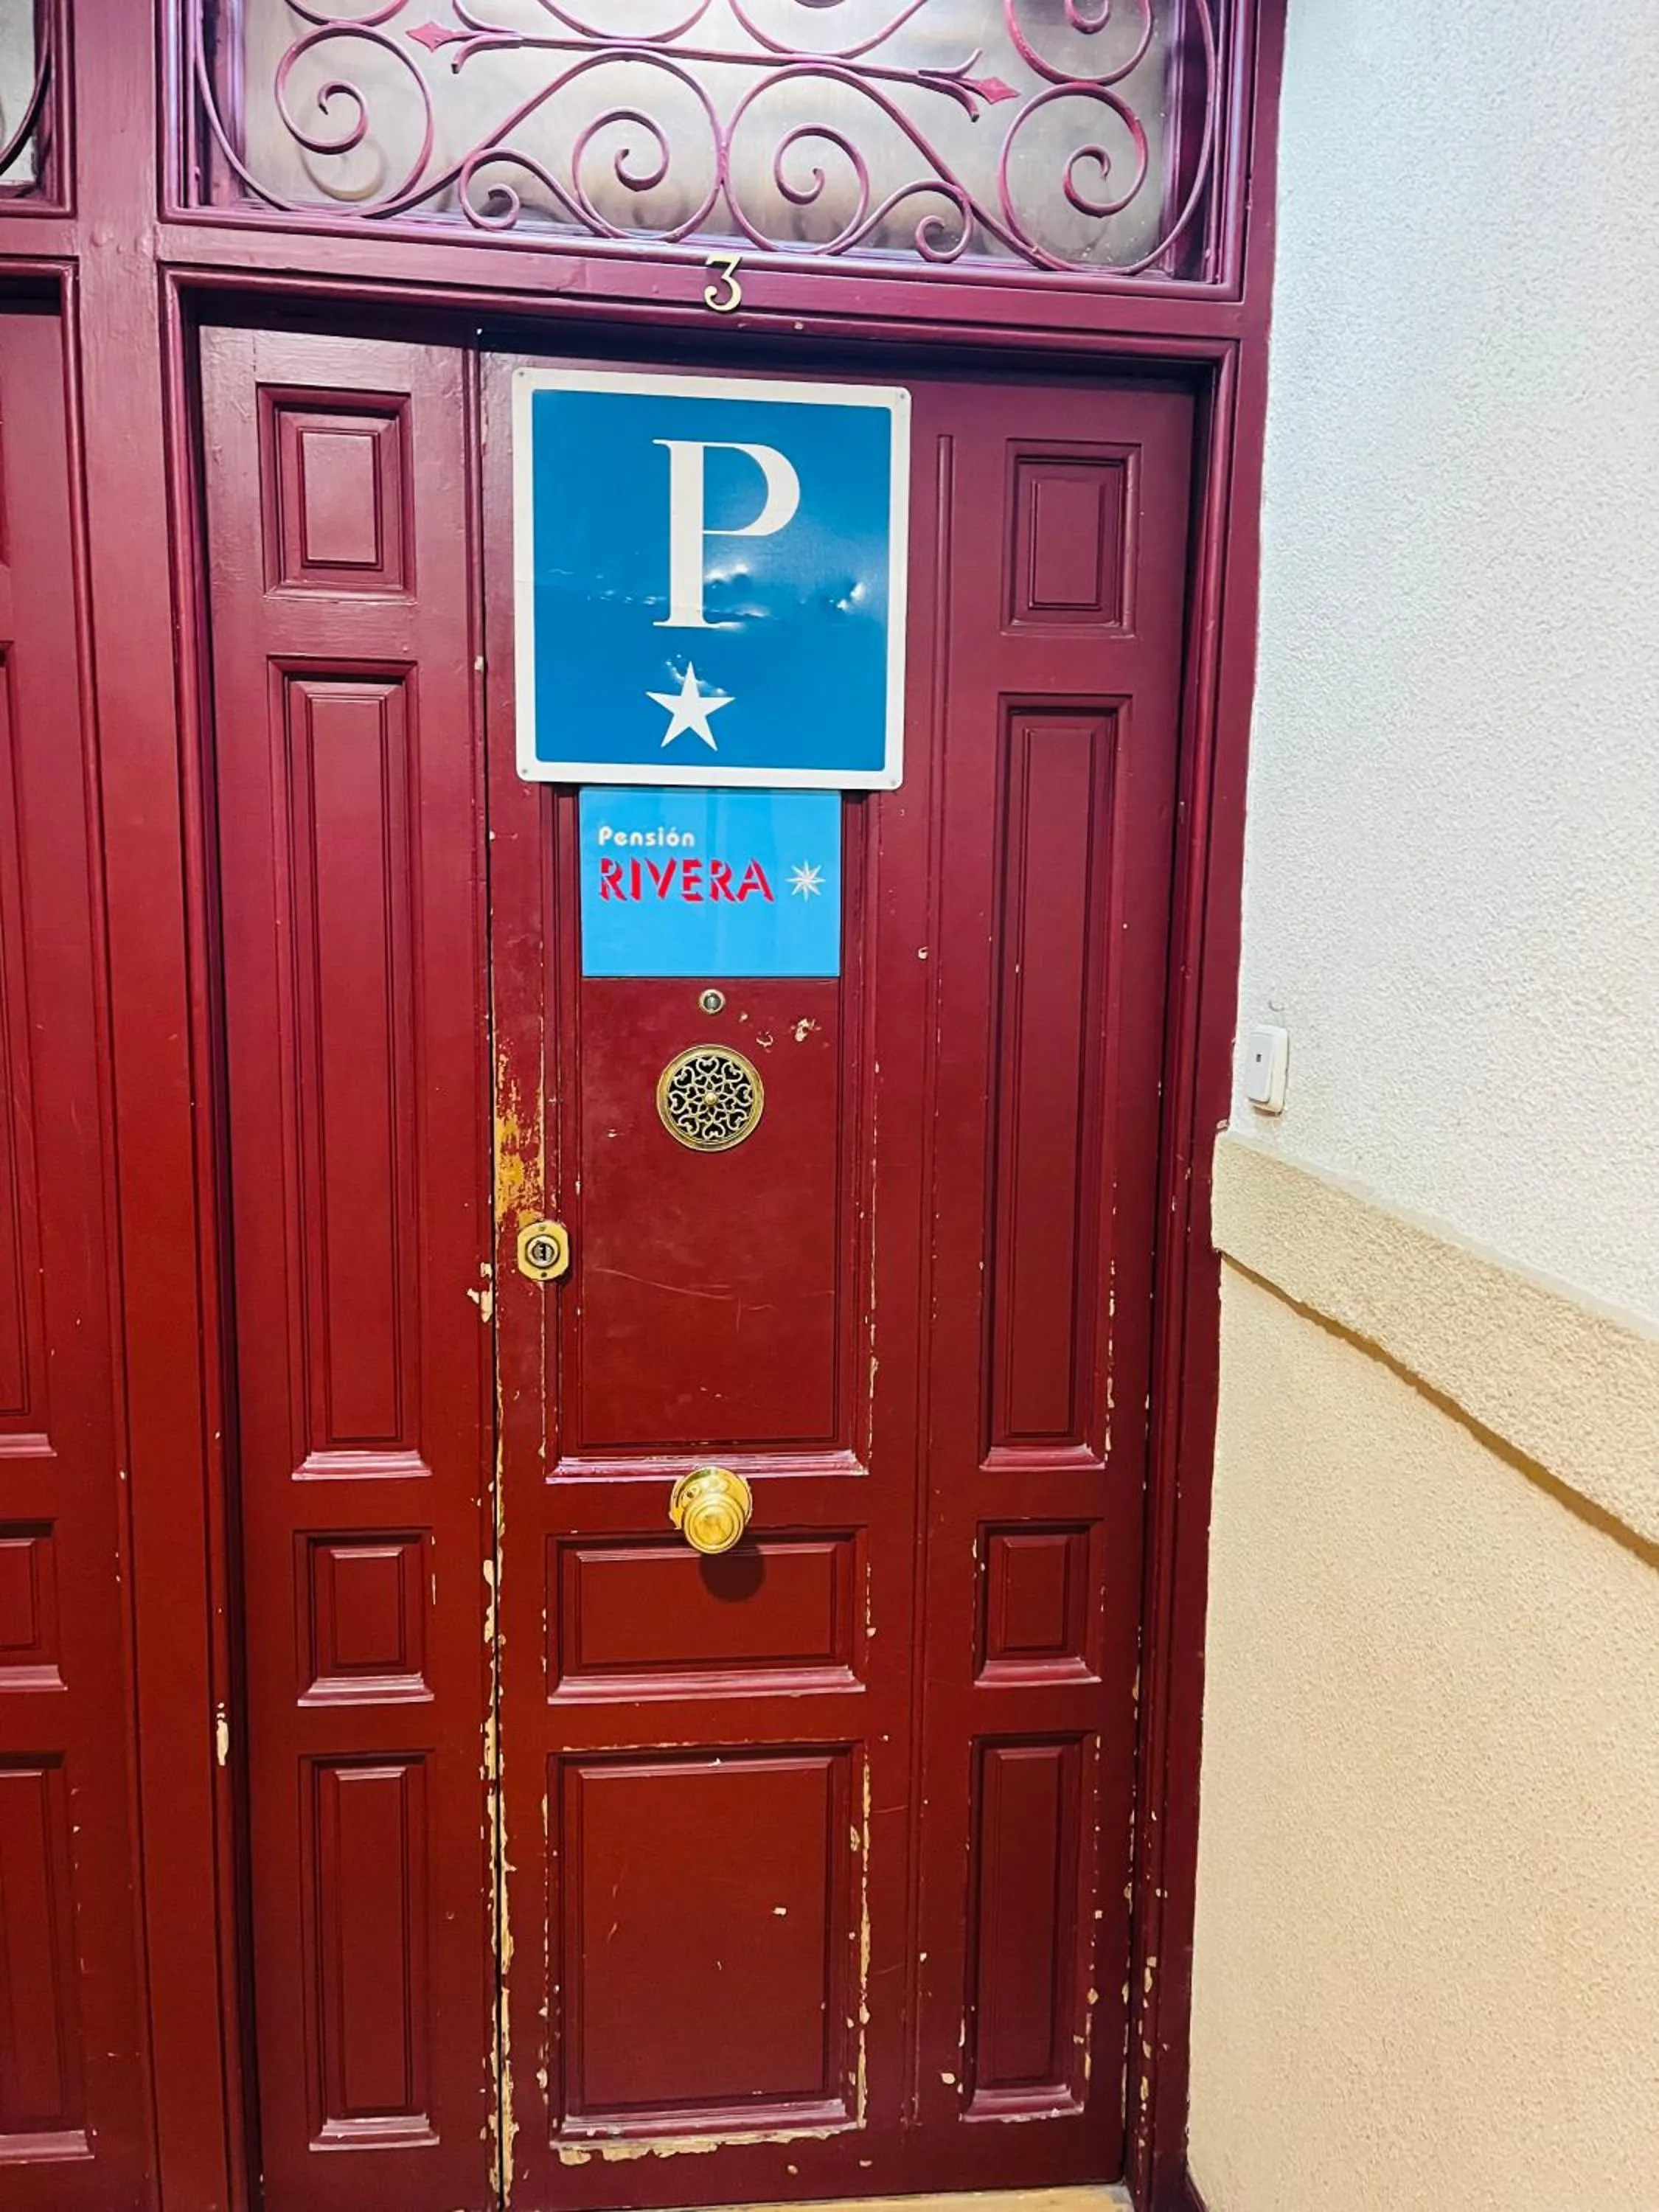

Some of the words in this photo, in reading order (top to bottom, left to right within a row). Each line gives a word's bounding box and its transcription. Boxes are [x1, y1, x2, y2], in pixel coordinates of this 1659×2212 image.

[704, 253, 742, 312] 3
[653, 439, 801, 629] P
[598, 825, 695, 847] Pensión
[599, 856, 774, 902] RIVERA
